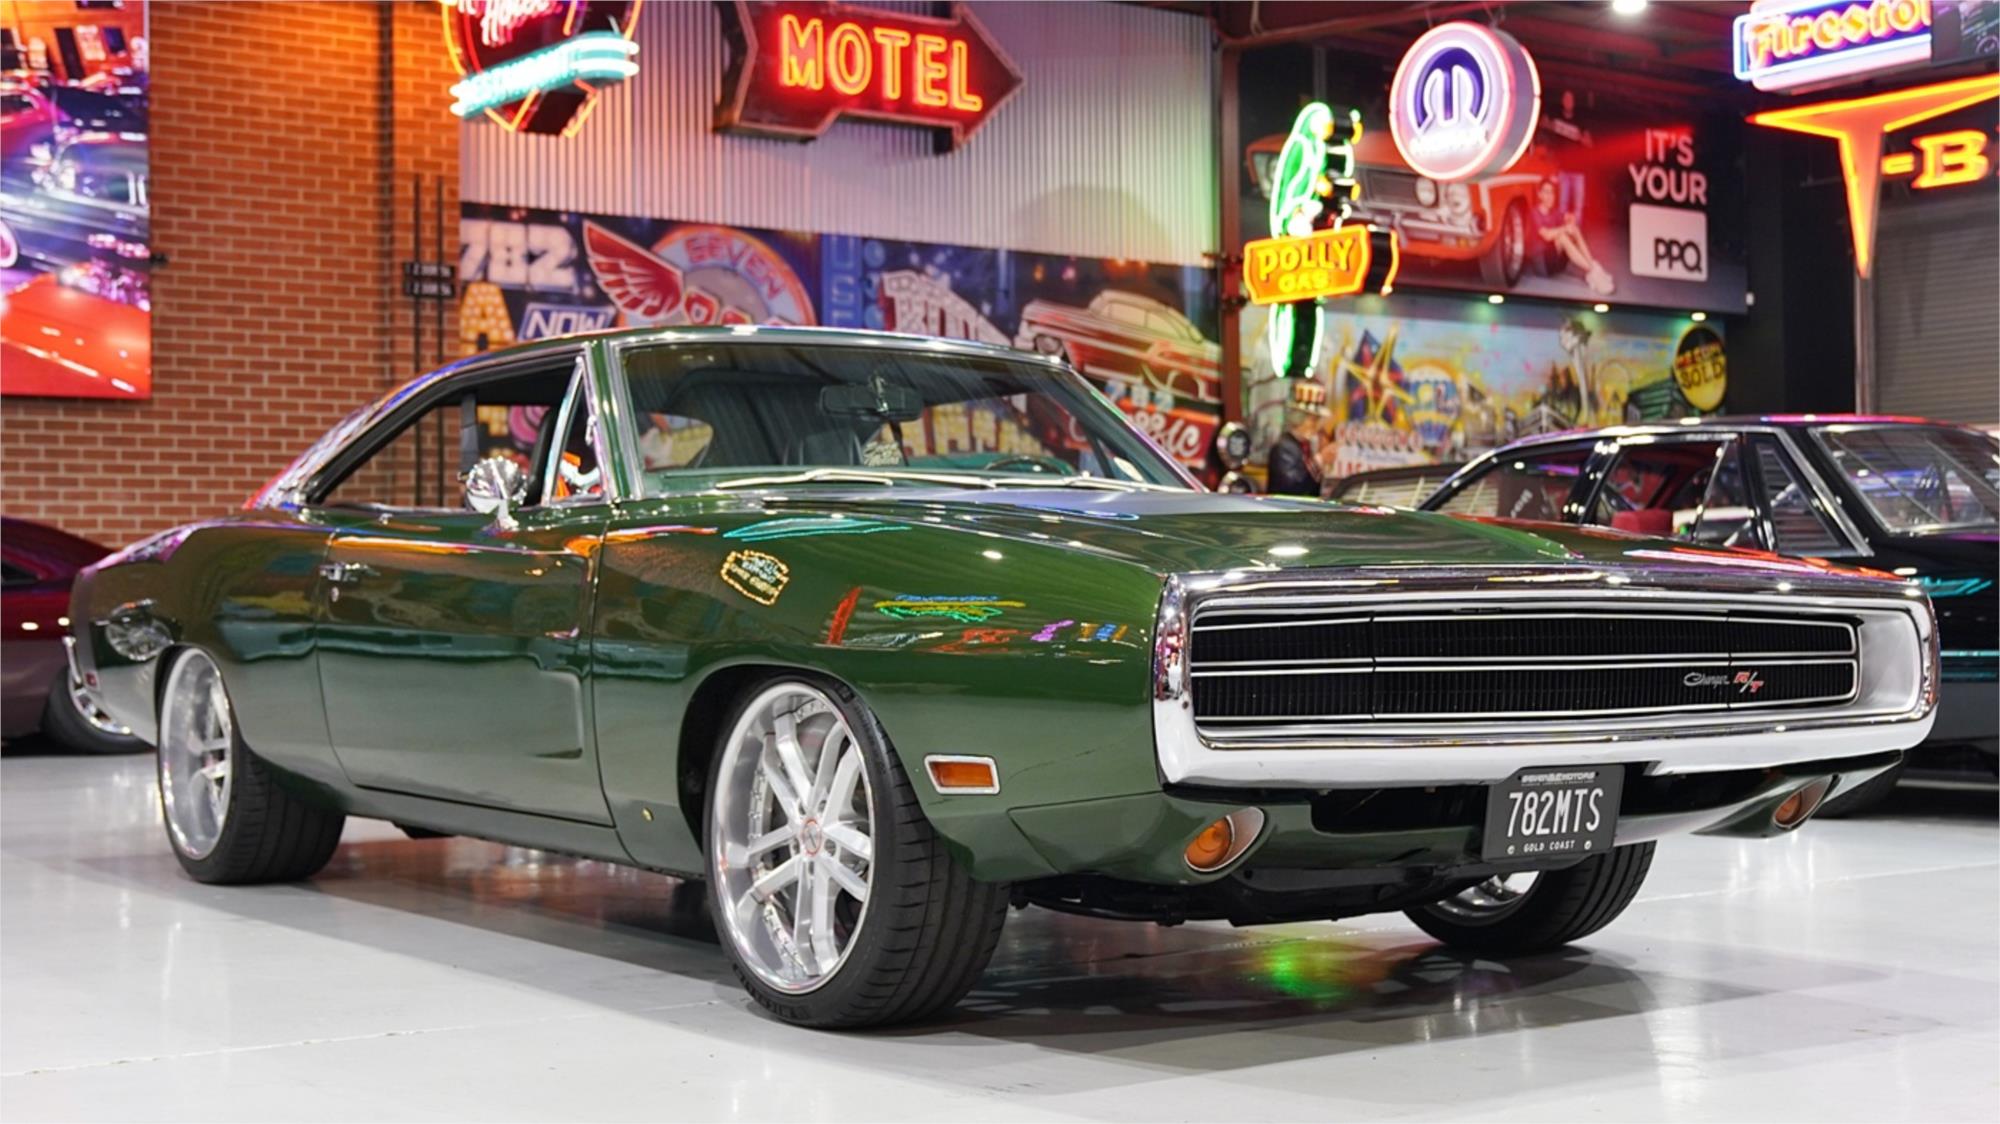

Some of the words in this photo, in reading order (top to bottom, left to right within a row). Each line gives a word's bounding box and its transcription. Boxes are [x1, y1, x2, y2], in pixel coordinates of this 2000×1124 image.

[778, 14, 983, 112] MOTEL
[1644, 128, 1695, 167] IT'S
[1628, 162, 1708, 205] YOUR
[459, 218, 579, 291] 782
[685, 235, 786, 301] SEVEN
[1257, 238, 1355, 282] POLLY
[1653, 236, 1703, 274] PPQ
[1277, 269, 1330, 293] GAS
[526, 311, 606, 338] NOW
[1680, 360, 1723, 391] SOLD
[1507, 787, 1604, 838] 782MTS
[1523, 842, 1545, 853] GOLD
[1549, 839, 1576, 851] COAST
